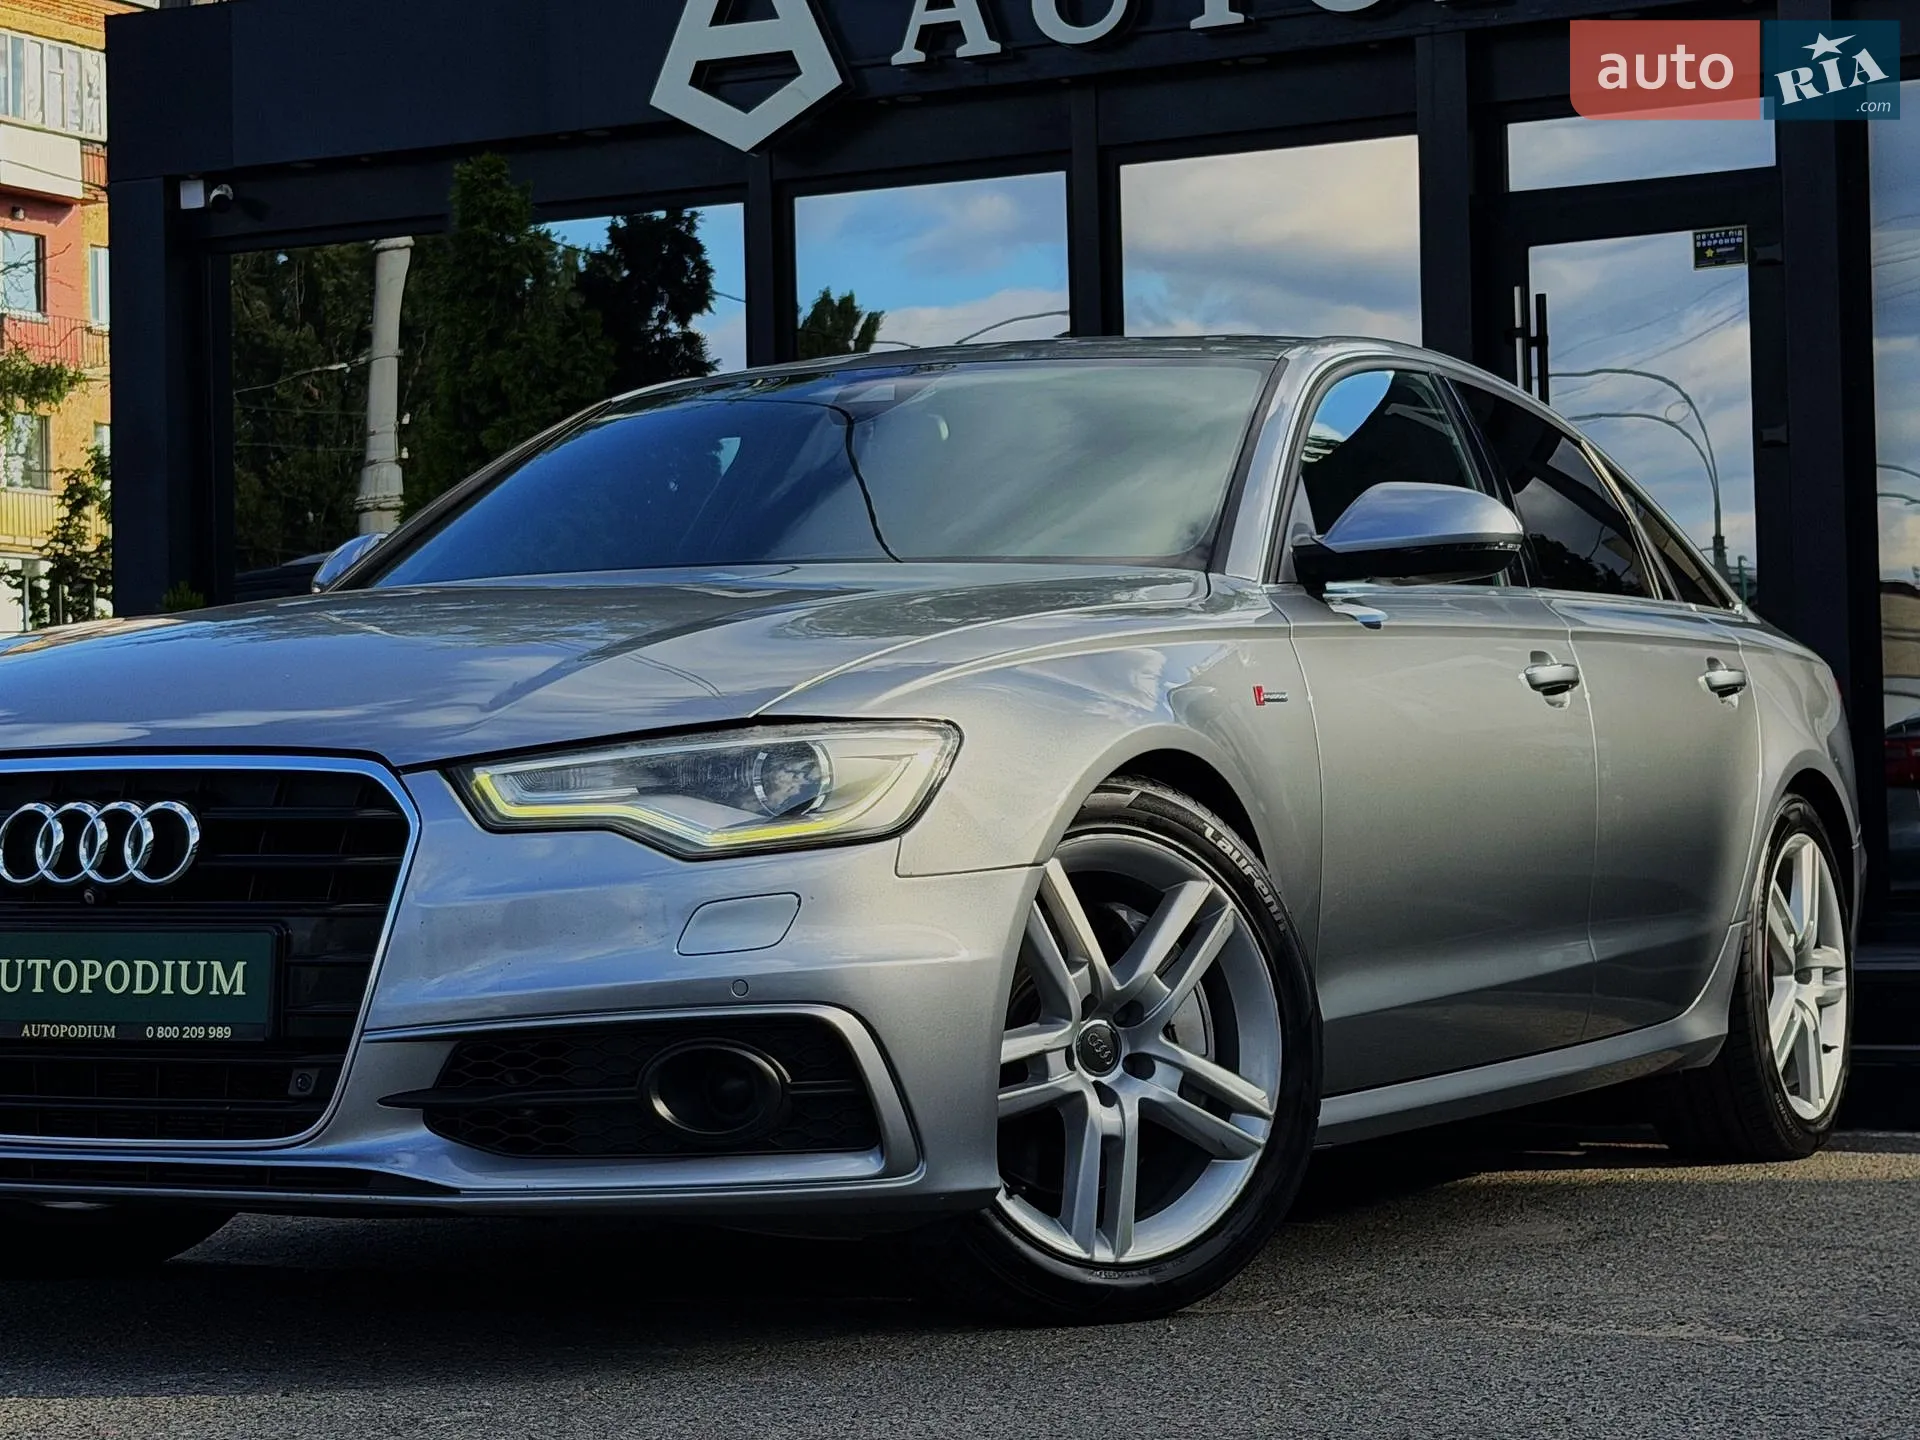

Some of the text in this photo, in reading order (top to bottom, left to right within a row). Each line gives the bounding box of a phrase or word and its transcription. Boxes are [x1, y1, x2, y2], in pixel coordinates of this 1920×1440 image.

[21, 1024, 232, 1039] AUTOPODIUM 0 800 209 989
